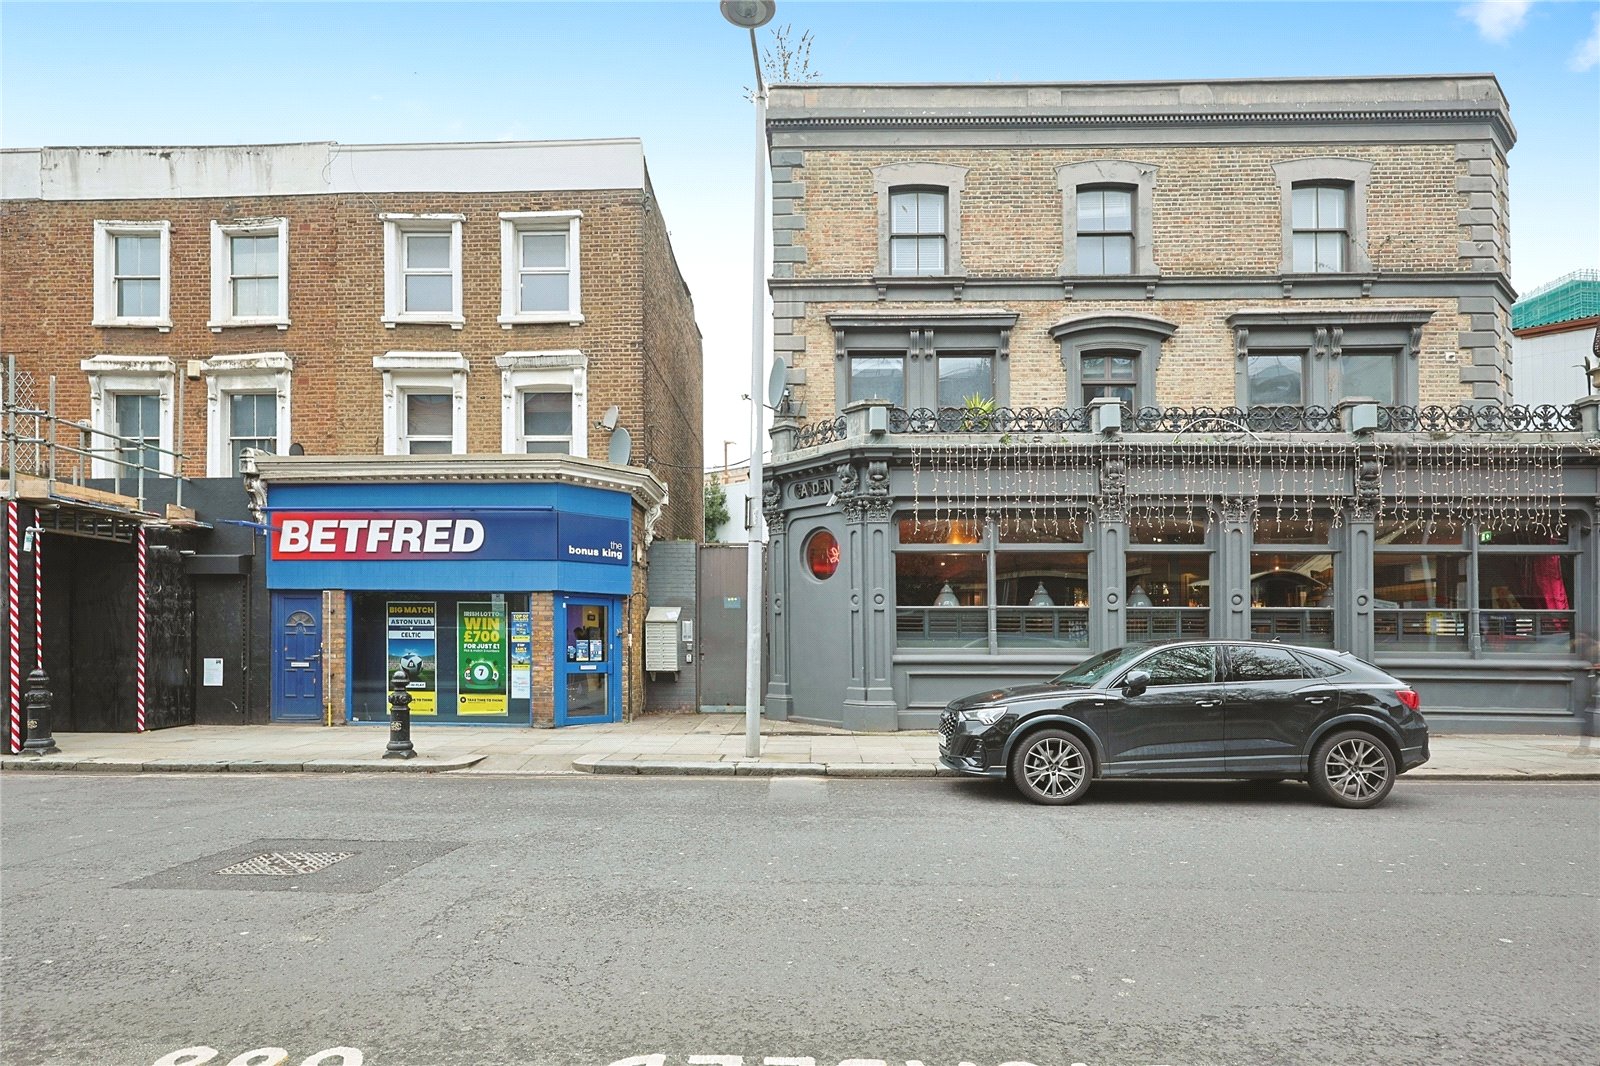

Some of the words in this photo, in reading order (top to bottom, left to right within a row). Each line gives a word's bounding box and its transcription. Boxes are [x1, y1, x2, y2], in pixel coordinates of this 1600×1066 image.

[278, 519, 485, 553] BETFRED
[610, 541, 622, 550] the
[568, 545, 599, 556] bonus
[602, 548, 622, 560] king
[389, 606, 403, 614] BIG
[404, 606, 434, 614] MATCH
[464, 617, 500, 630] WIN
[464, 630, 500, 643] £700
[478, 668, 485, 677] 7
